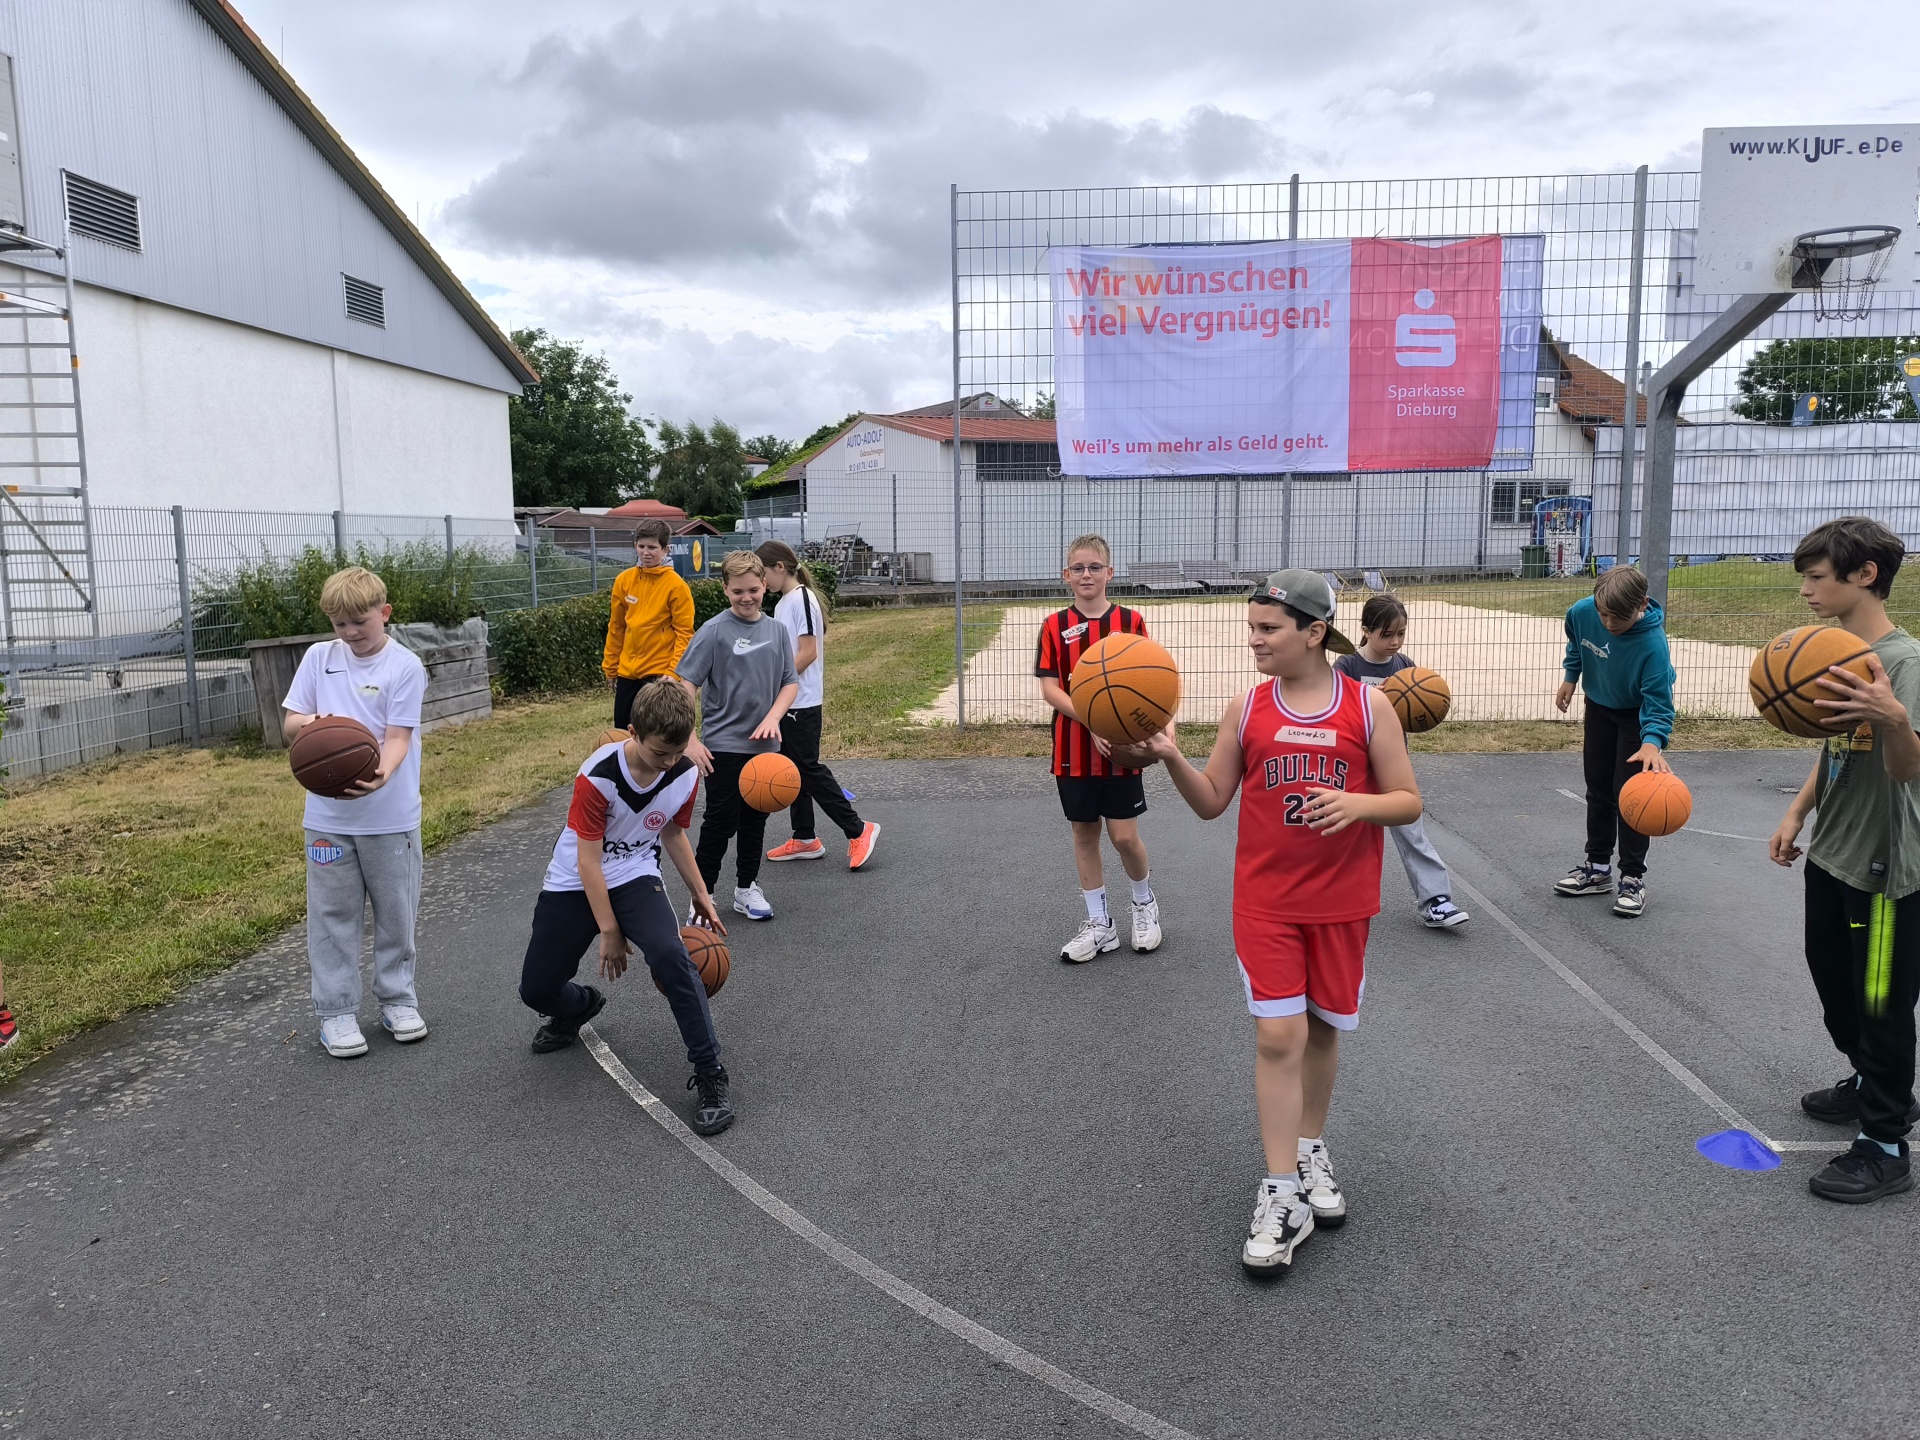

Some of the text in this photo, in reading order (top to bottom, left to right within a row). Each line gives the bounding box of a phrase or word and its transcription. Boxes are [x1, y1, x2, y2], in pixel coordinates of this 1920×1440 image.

[1066, 261, 1308, 297] Wir wünschen
[1068, 299, 1332, 341] viel Vergnügen!
[1387, 383, 1466, 402] Sparkasse
[1396, 403, 1458, 419] Dieburg
[846, 428, 882, 448] AUTO-ADOLF
[1071, 433, 1329, 454] Weil's um mehr als Geld geht.
[1264, 753, 1349, 792] BULLS
[307, 847, 342, 864] WIZARDS
